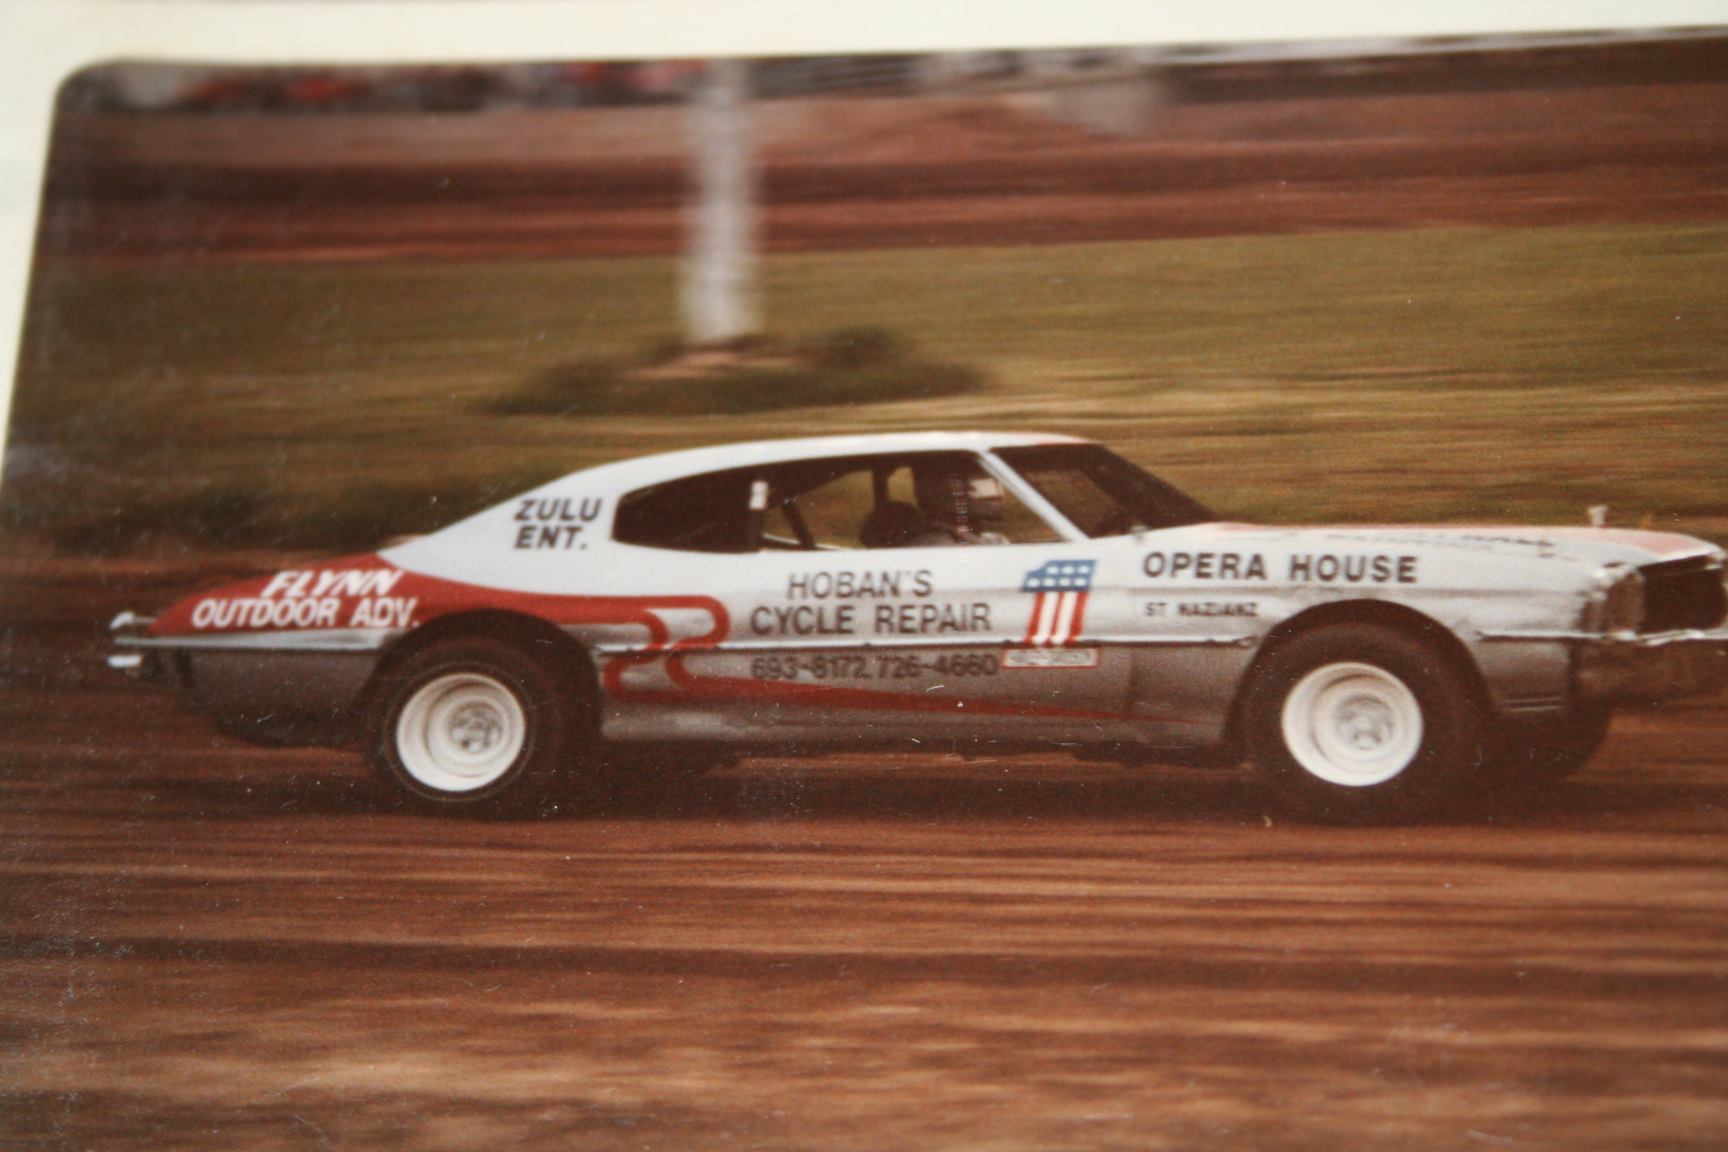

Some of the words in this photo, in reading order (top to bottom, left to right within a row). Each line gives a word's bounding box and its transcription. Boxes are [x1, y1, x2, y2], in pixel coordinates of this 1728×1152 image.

[512, 498, 603, 521] ZULU
[512, 524, 588, 549] ENT.
[1143, 551, 1267, 580] OPERA
[1289, 553, 1419, 584] HOUSE
[260, 569, 403, 598] FLYNN
[788, 569, 934, 600] HOBAN'S
[191, 598, 342, 629] OUTDOOR
[350, 597, 421, 629] ADV.
[750, 604, 856, 637] CYCLE
[874, 601, 994, 634] REPAIR
